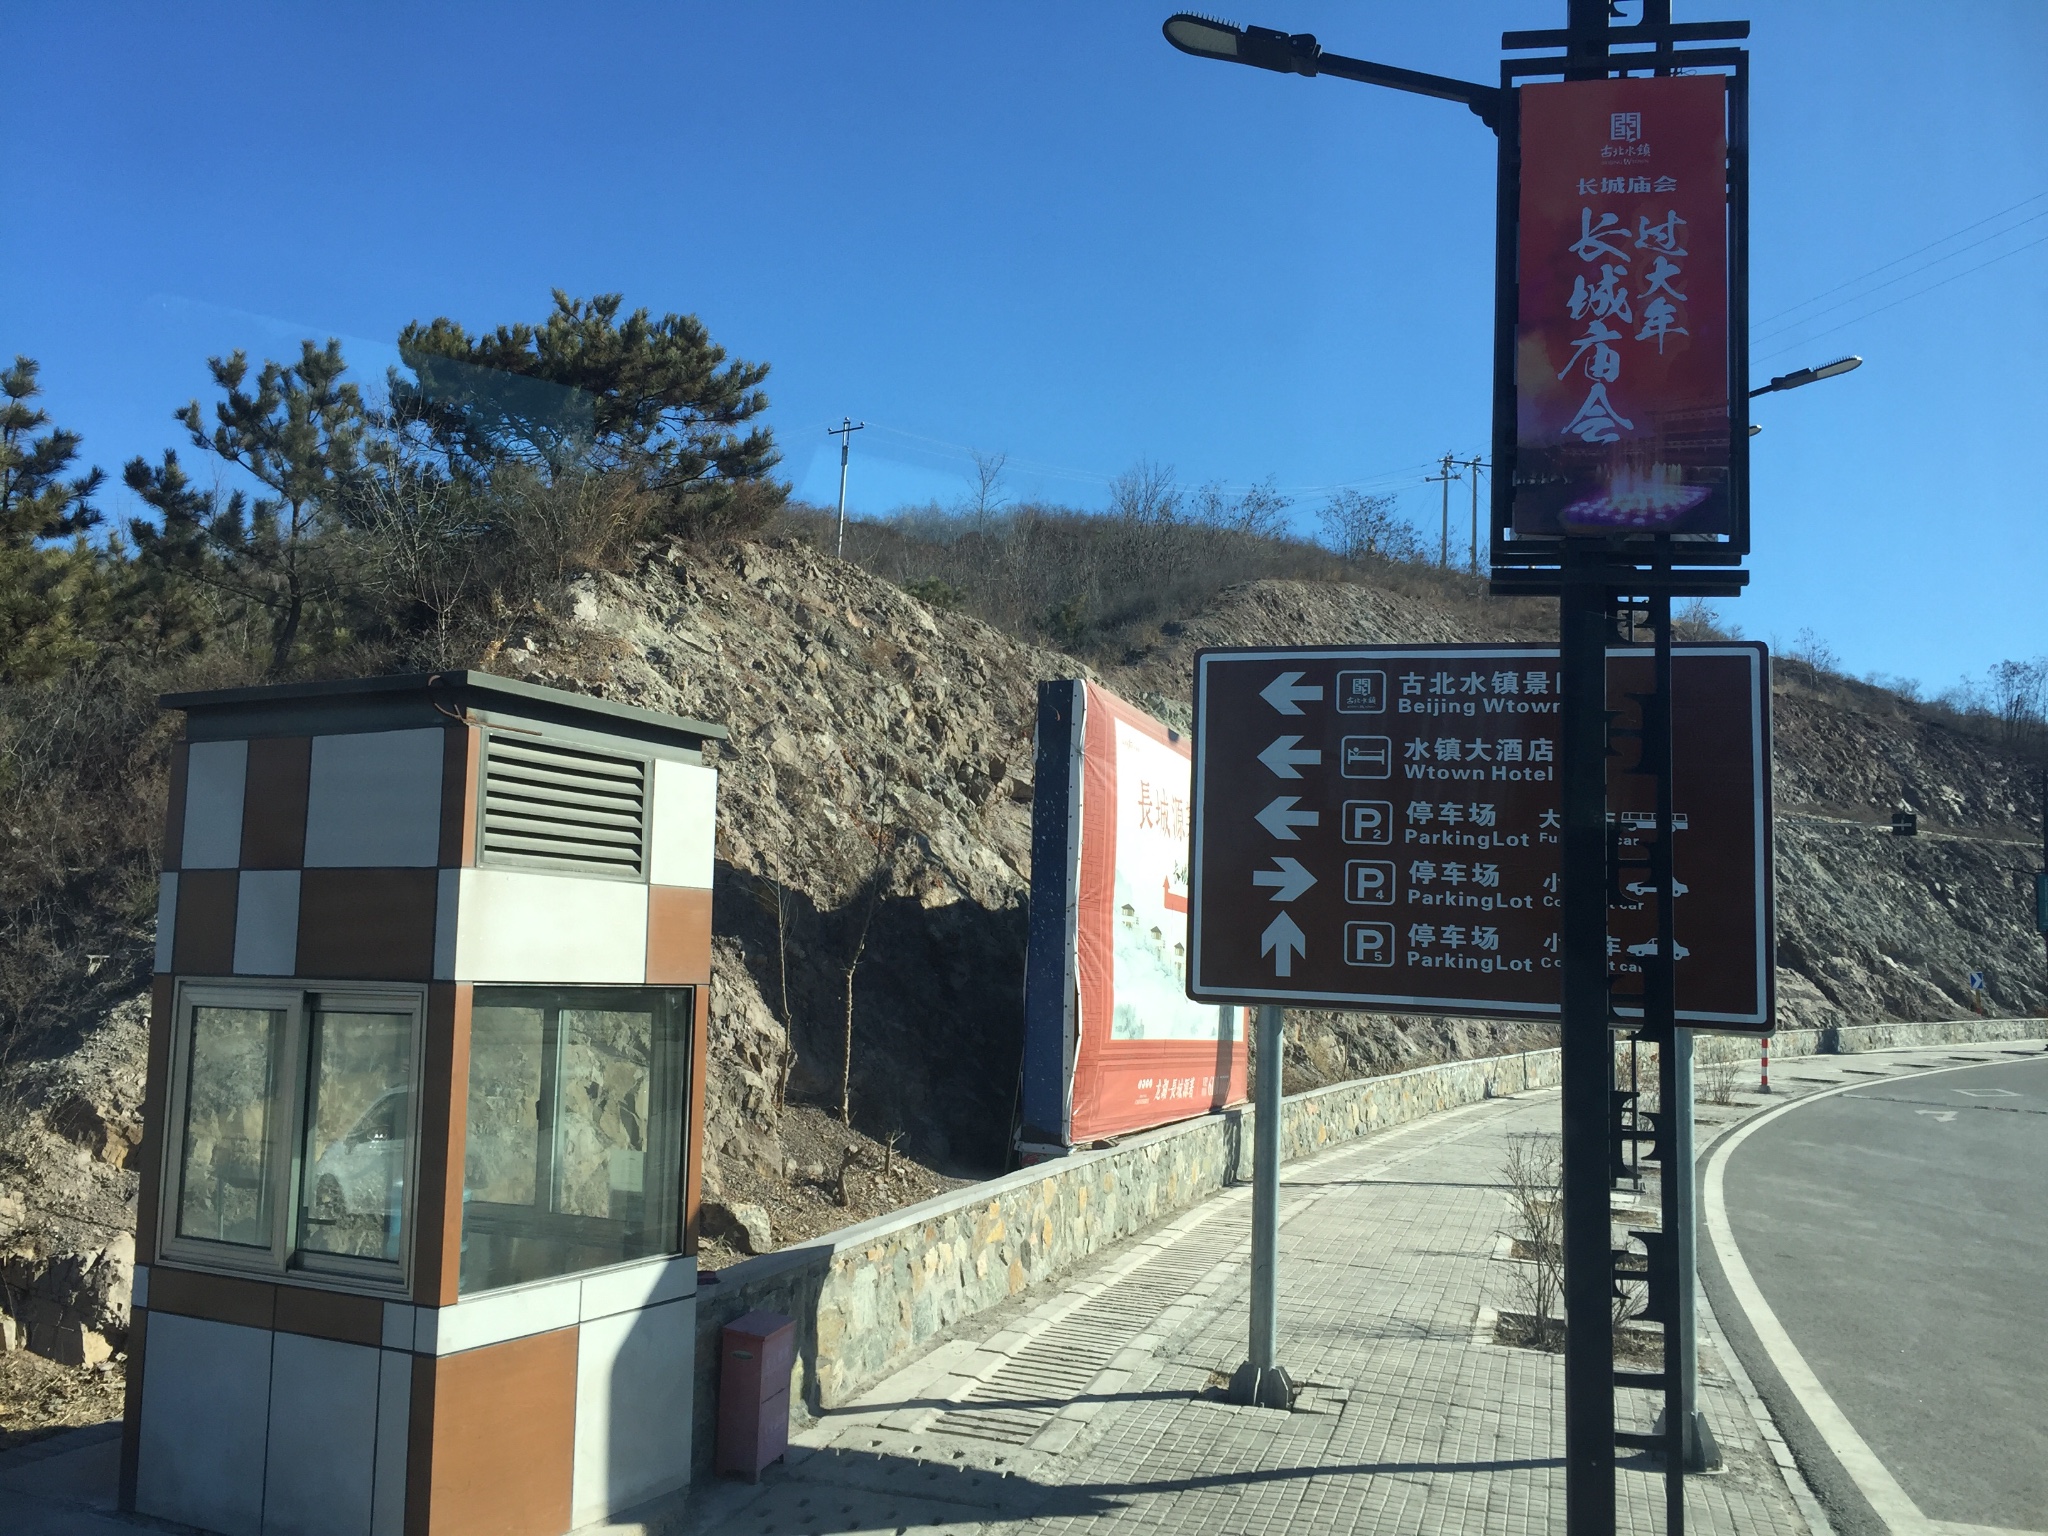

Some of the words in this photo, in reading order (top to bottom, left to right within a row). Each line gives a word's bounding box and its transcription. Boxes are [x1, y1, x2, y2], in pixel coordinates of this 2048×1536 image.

[1576, 175, 1677, 195] 长城庙会
[1634, 208, 1689, 355] 过大年
[1399, 671, 1560, 695] 古北水镇景
[1399, 698, 1476, 716] Beijing
[1404, 737, 1553, 762] 水镇大酒店
[1404, 764, 1485, 780] Wtown
[1492, 766, 1553, 781] Hotel
[1406, 801, 1496, 827] 停车场
[1405, 829, 1530, 849] ParkingLot
[1409, 860, 1499, 887] 停车场
[1408, 889, 1533, 911] ParkingLot
[1408, 923, 1499, 950] 停车场
[1407, 951, 1533, 973] ParkingLot
